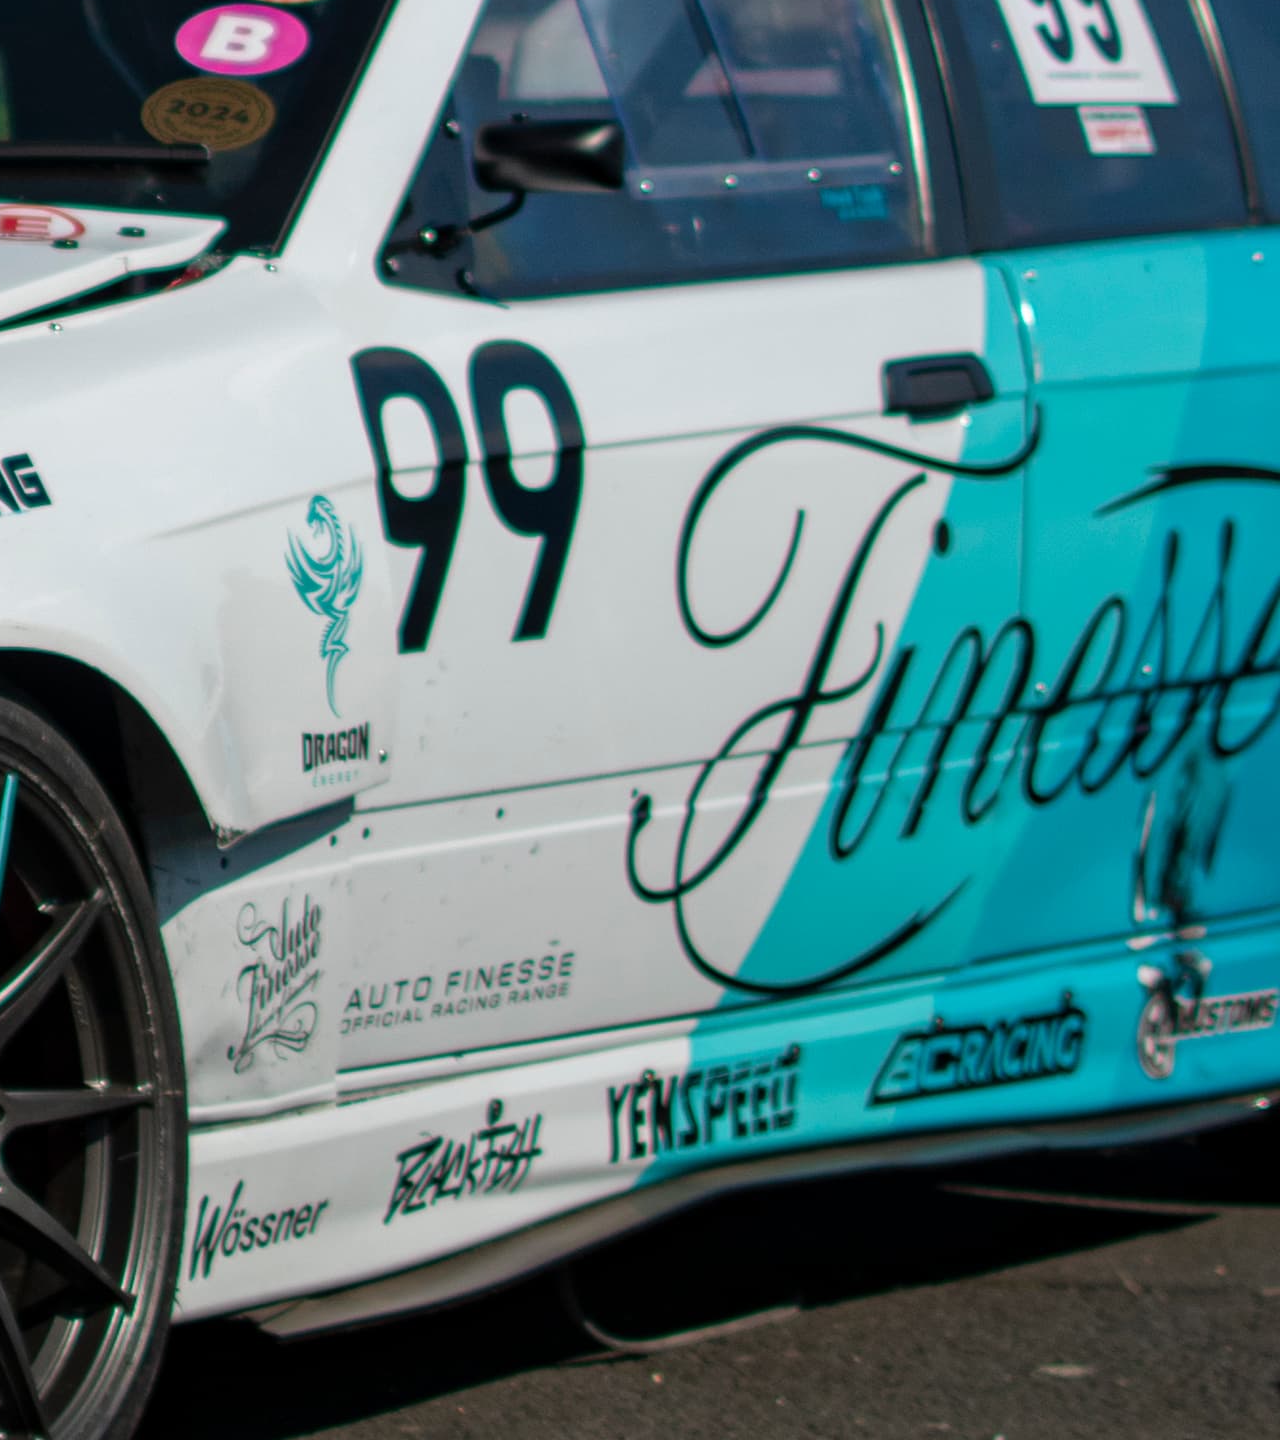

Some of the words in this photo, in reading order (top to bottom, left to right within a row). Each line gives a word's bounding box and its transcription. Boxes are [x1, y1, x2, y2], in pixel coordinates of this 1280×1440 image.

[199, 13, 276, 64] B
[348, 338, 586, 655] 99
[301, 720, 371, 773] DRAGON
[343, 975, 433, 1013] AUTO
[444, 951, 576, 997] FINESSE
[430, 991, 503, 1019] RACING
[507, 981, 571, 1005] RANGE
[188, 1178, 330, 1282] Wössner
